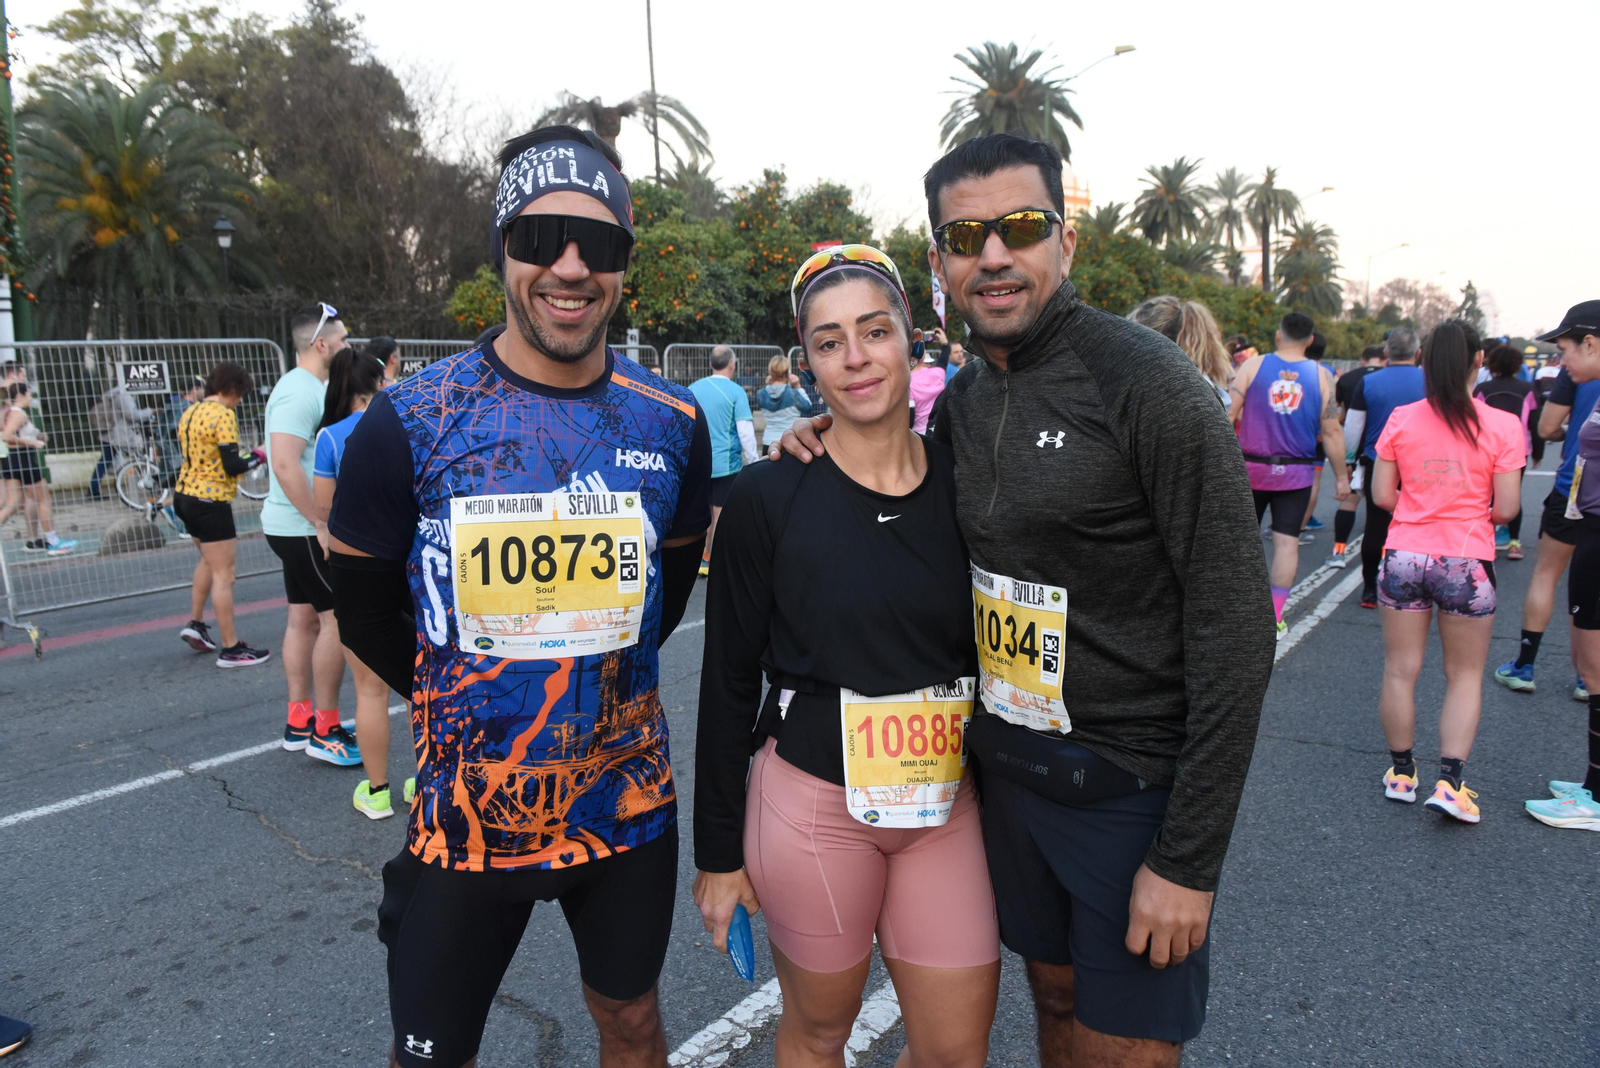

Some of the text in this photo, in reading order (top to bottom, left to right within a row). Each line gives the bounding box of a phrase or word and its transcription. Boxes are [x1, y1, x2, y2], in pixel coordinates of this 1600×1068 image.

[496, 159, 610, 228] SEVILLA
[130, 364, 159, 379] AMS
[403, 361, 424, 373] AMS
[615, 448, 667, 472] HOKA
[465, 494, 619, 516] MEDIO MARATÓN SEVILLA
[471, 532, 616, 586] 10873
[535, 586, 556, 594] Souf
[536, 604, 556, 612] Sadik
[978, 604, 1040, 666] 1034
[539, 638, 566, 649] HOKA
[857, 713, 962, 759] 10885
[919, 759, 938, 767] OUAJ
[1029, 764, 1049, 775] SOFT
[916, 809, 937, 818] HOKA
